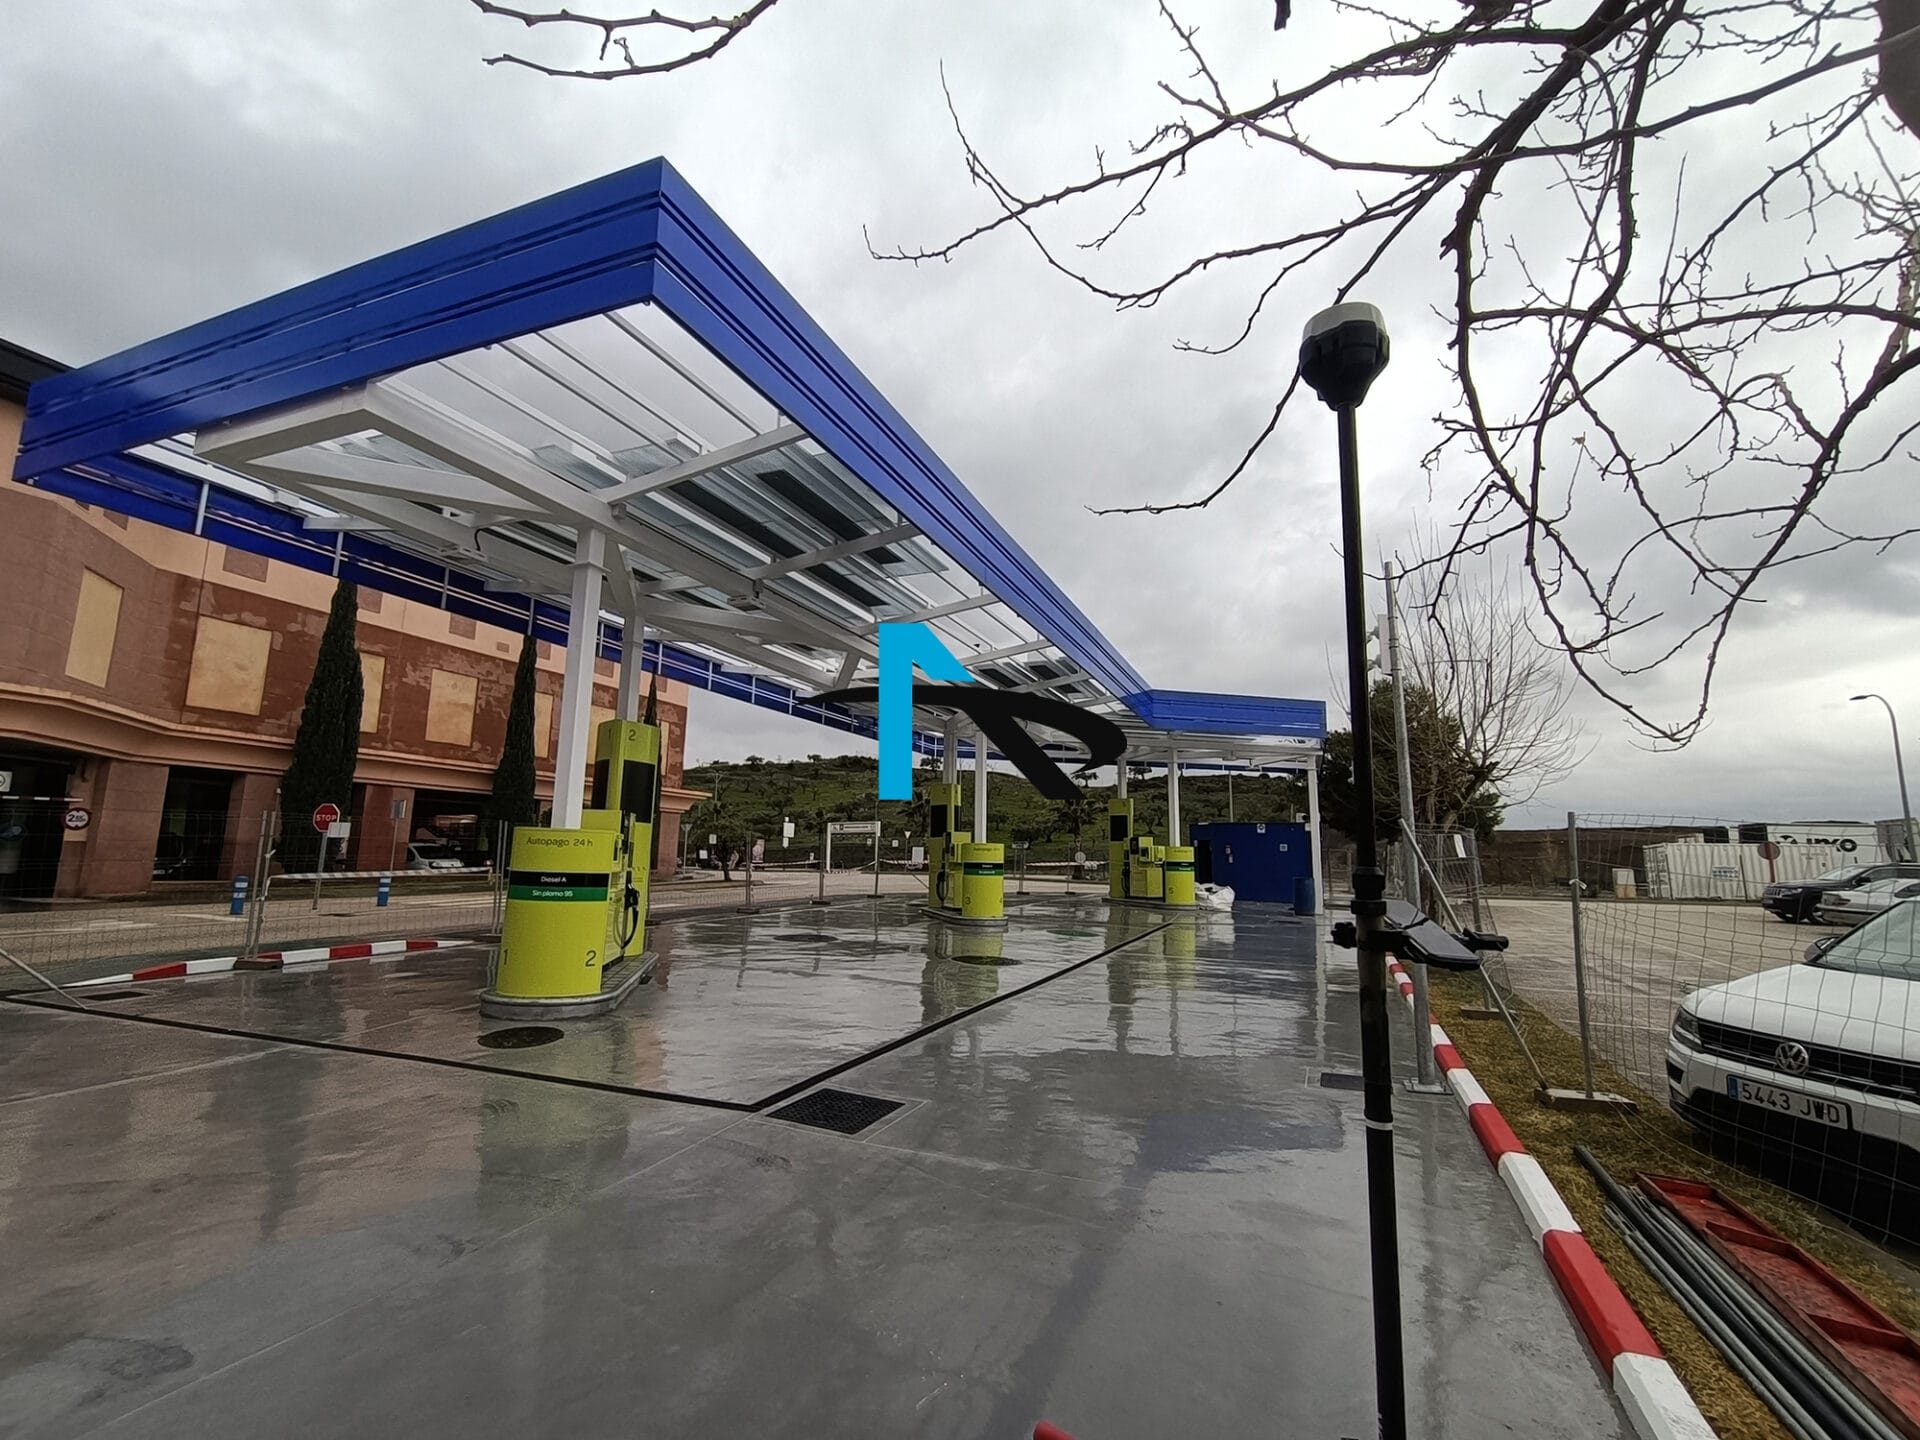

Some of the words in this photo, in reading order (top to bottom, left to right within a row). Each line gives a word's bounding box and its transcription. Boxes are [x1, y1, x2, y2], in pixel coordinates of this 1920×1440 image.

[628, 728, 637, 741] 2
[315, 814, 337, 822] STOP
[526, 836, 570, 849] Autopago
[572, 838, 585, 848] 24
[540, 875, 561, 883] Diesel
[532, 889, 542, 897] Sin
[542, 889, 564, 898] plomo
[564, 889, 574, 898] 95
[964, 896, 972, 905] 3
[503, 948, 509, 966] 1
[584, 949, 598, 968] 2
[1742, 1082, 1791, 1111] 5443
[1800, 1098, 1841, 1124] JWD
